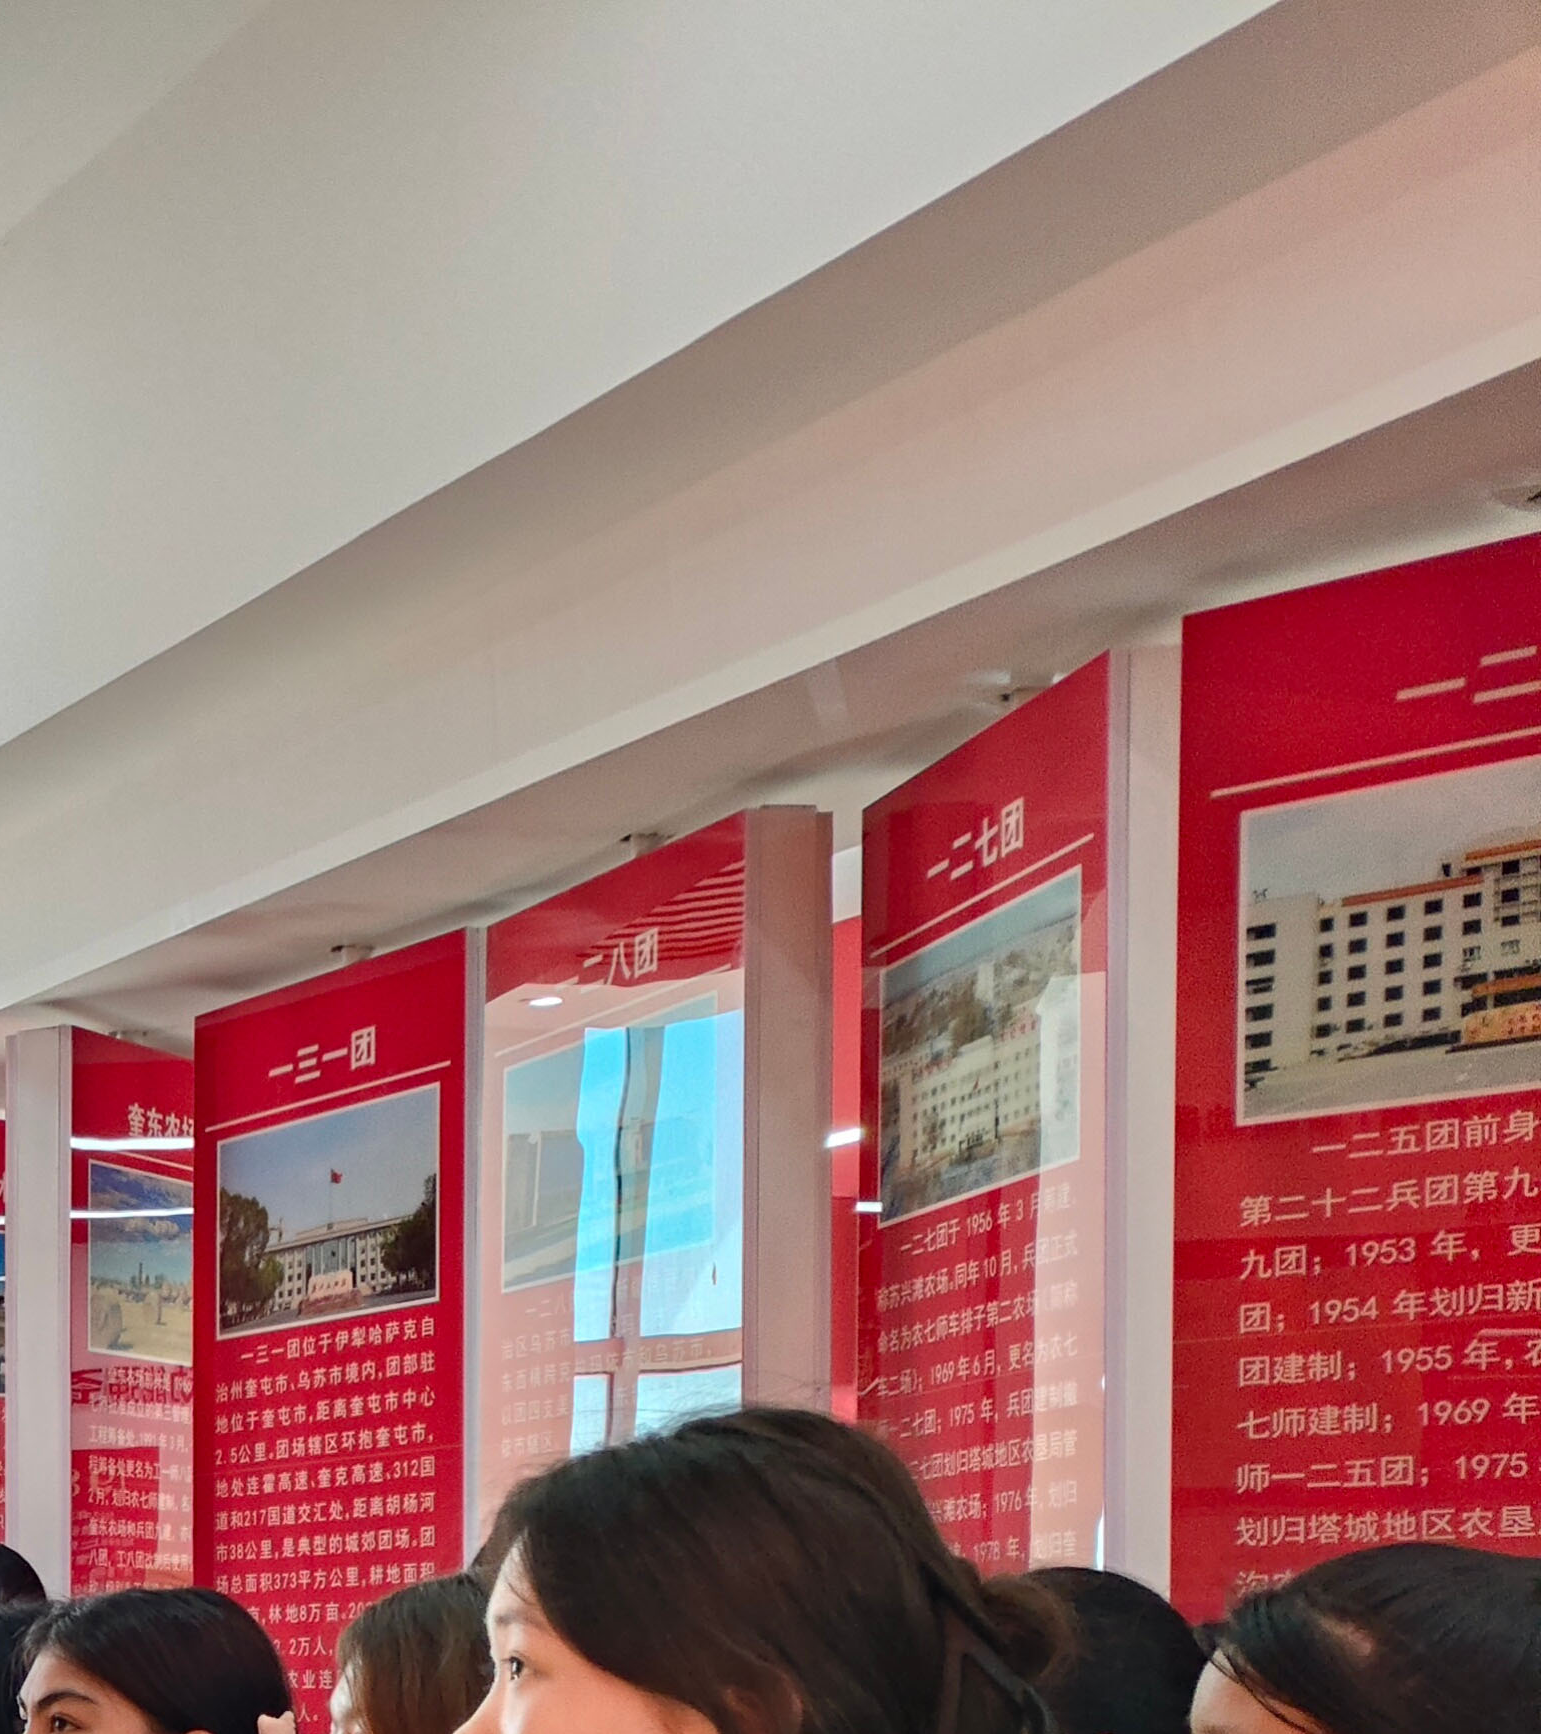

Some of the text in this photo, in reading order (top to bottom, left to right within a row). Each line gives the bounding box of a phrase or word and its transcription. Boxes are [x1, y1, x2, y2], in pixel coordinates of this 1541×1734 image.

[925, 795, 1026, 882] 一二七团
[268, 1025, 377, 1085] 一三一团
[1311, 1111, 1541, 1159] 一二五团前身
[1238, 1167, 1541, 1229] 第二十二兵团第九
[1238, 1224, 1541, 1284] 九团；1953年，更
[240, 1315, 436, 1364] 一三一团位于伊犁哈萨克自
[214, 1351, 436, 1404] 治州奎屯市、乌苏市境内，团部驻
[214, 1385, 436, 1436] 地位于奎屯市，距离奎屯市中心
[1235, 1390, 1541, 1443] 七师建制；1969年
[214, 1420, 435, 1467] 2.5公里。团场辖区环抱奎屯市，
[214, 1455, 436, 1499] 地处连霍高速、奎克高速、312国
[1235, 1448, 1541, 1497] 师一二五团；1975
[214, 1491, 436, 1532] 道和217国道交汇处，距离胡杨河
[1235, 1505, 1541, 1548] 划归塔城地区农垦
[215, 1525, 436, 1564] 市38公里，是典型的城郊团场。团
